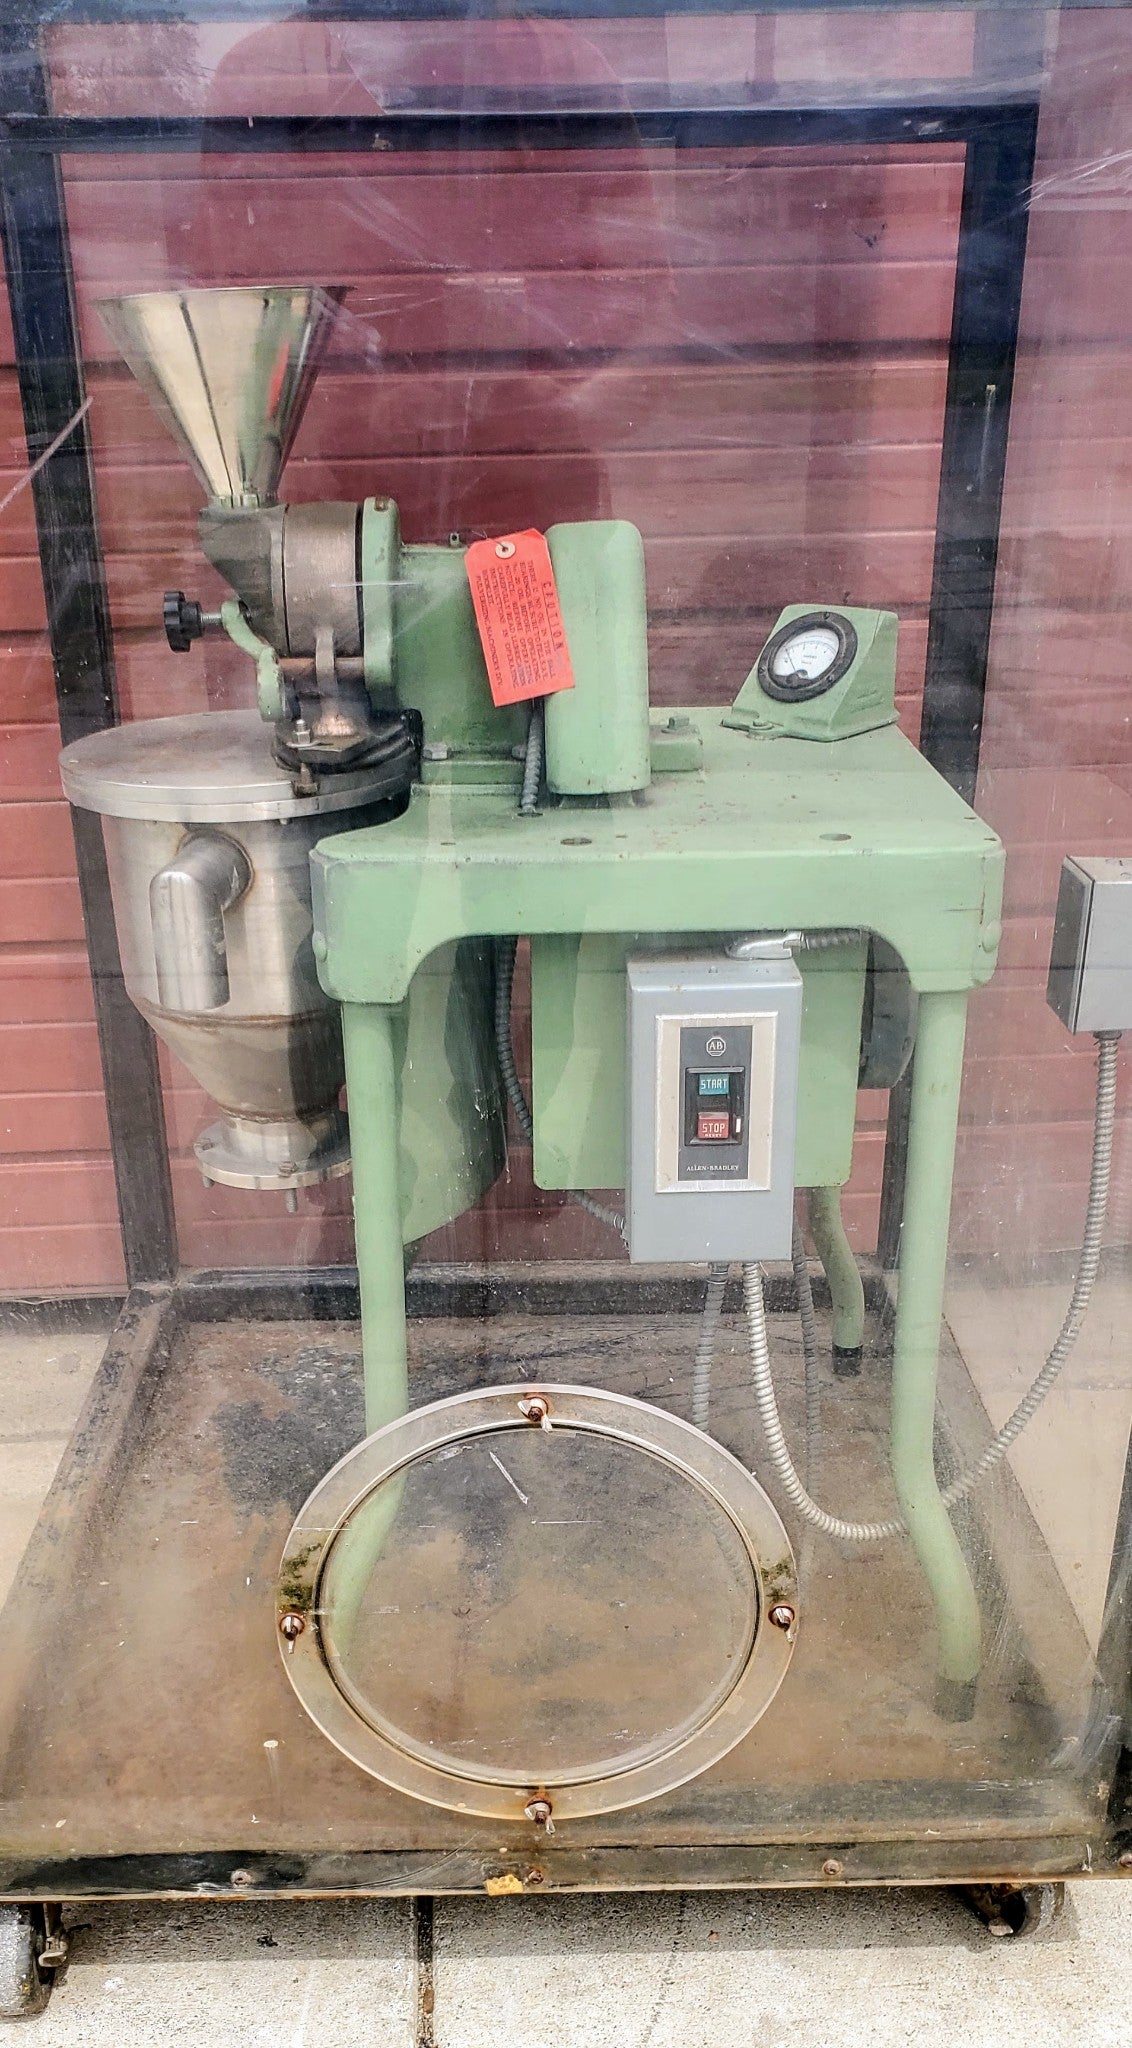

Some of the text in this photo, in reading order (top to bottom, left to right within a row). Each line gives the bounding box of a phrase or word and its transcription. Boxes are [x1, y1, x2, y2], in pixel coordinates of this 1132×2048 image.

[511, 601, 522, 631] BEFORE
[516, 588, 524, 600] OIL
[520, 604, 531, 633] BEFORE
[526, 560, 536, 583] THERE
[534, 597, 542, 609] NO
[543, 640, 551, 655] THE
[542, 582, 564, 650] CAUTION
[506, 612, 515, 633] READ
[529, 611, 538, 629] SURE
[501, 629, 508, 637] IN
[533, 630, 541, 642] TO
[709, 1041, 723, 1051] AB
[700, 1079, 728, 1090] START
[702, 1123, 725, 1133] STOP
